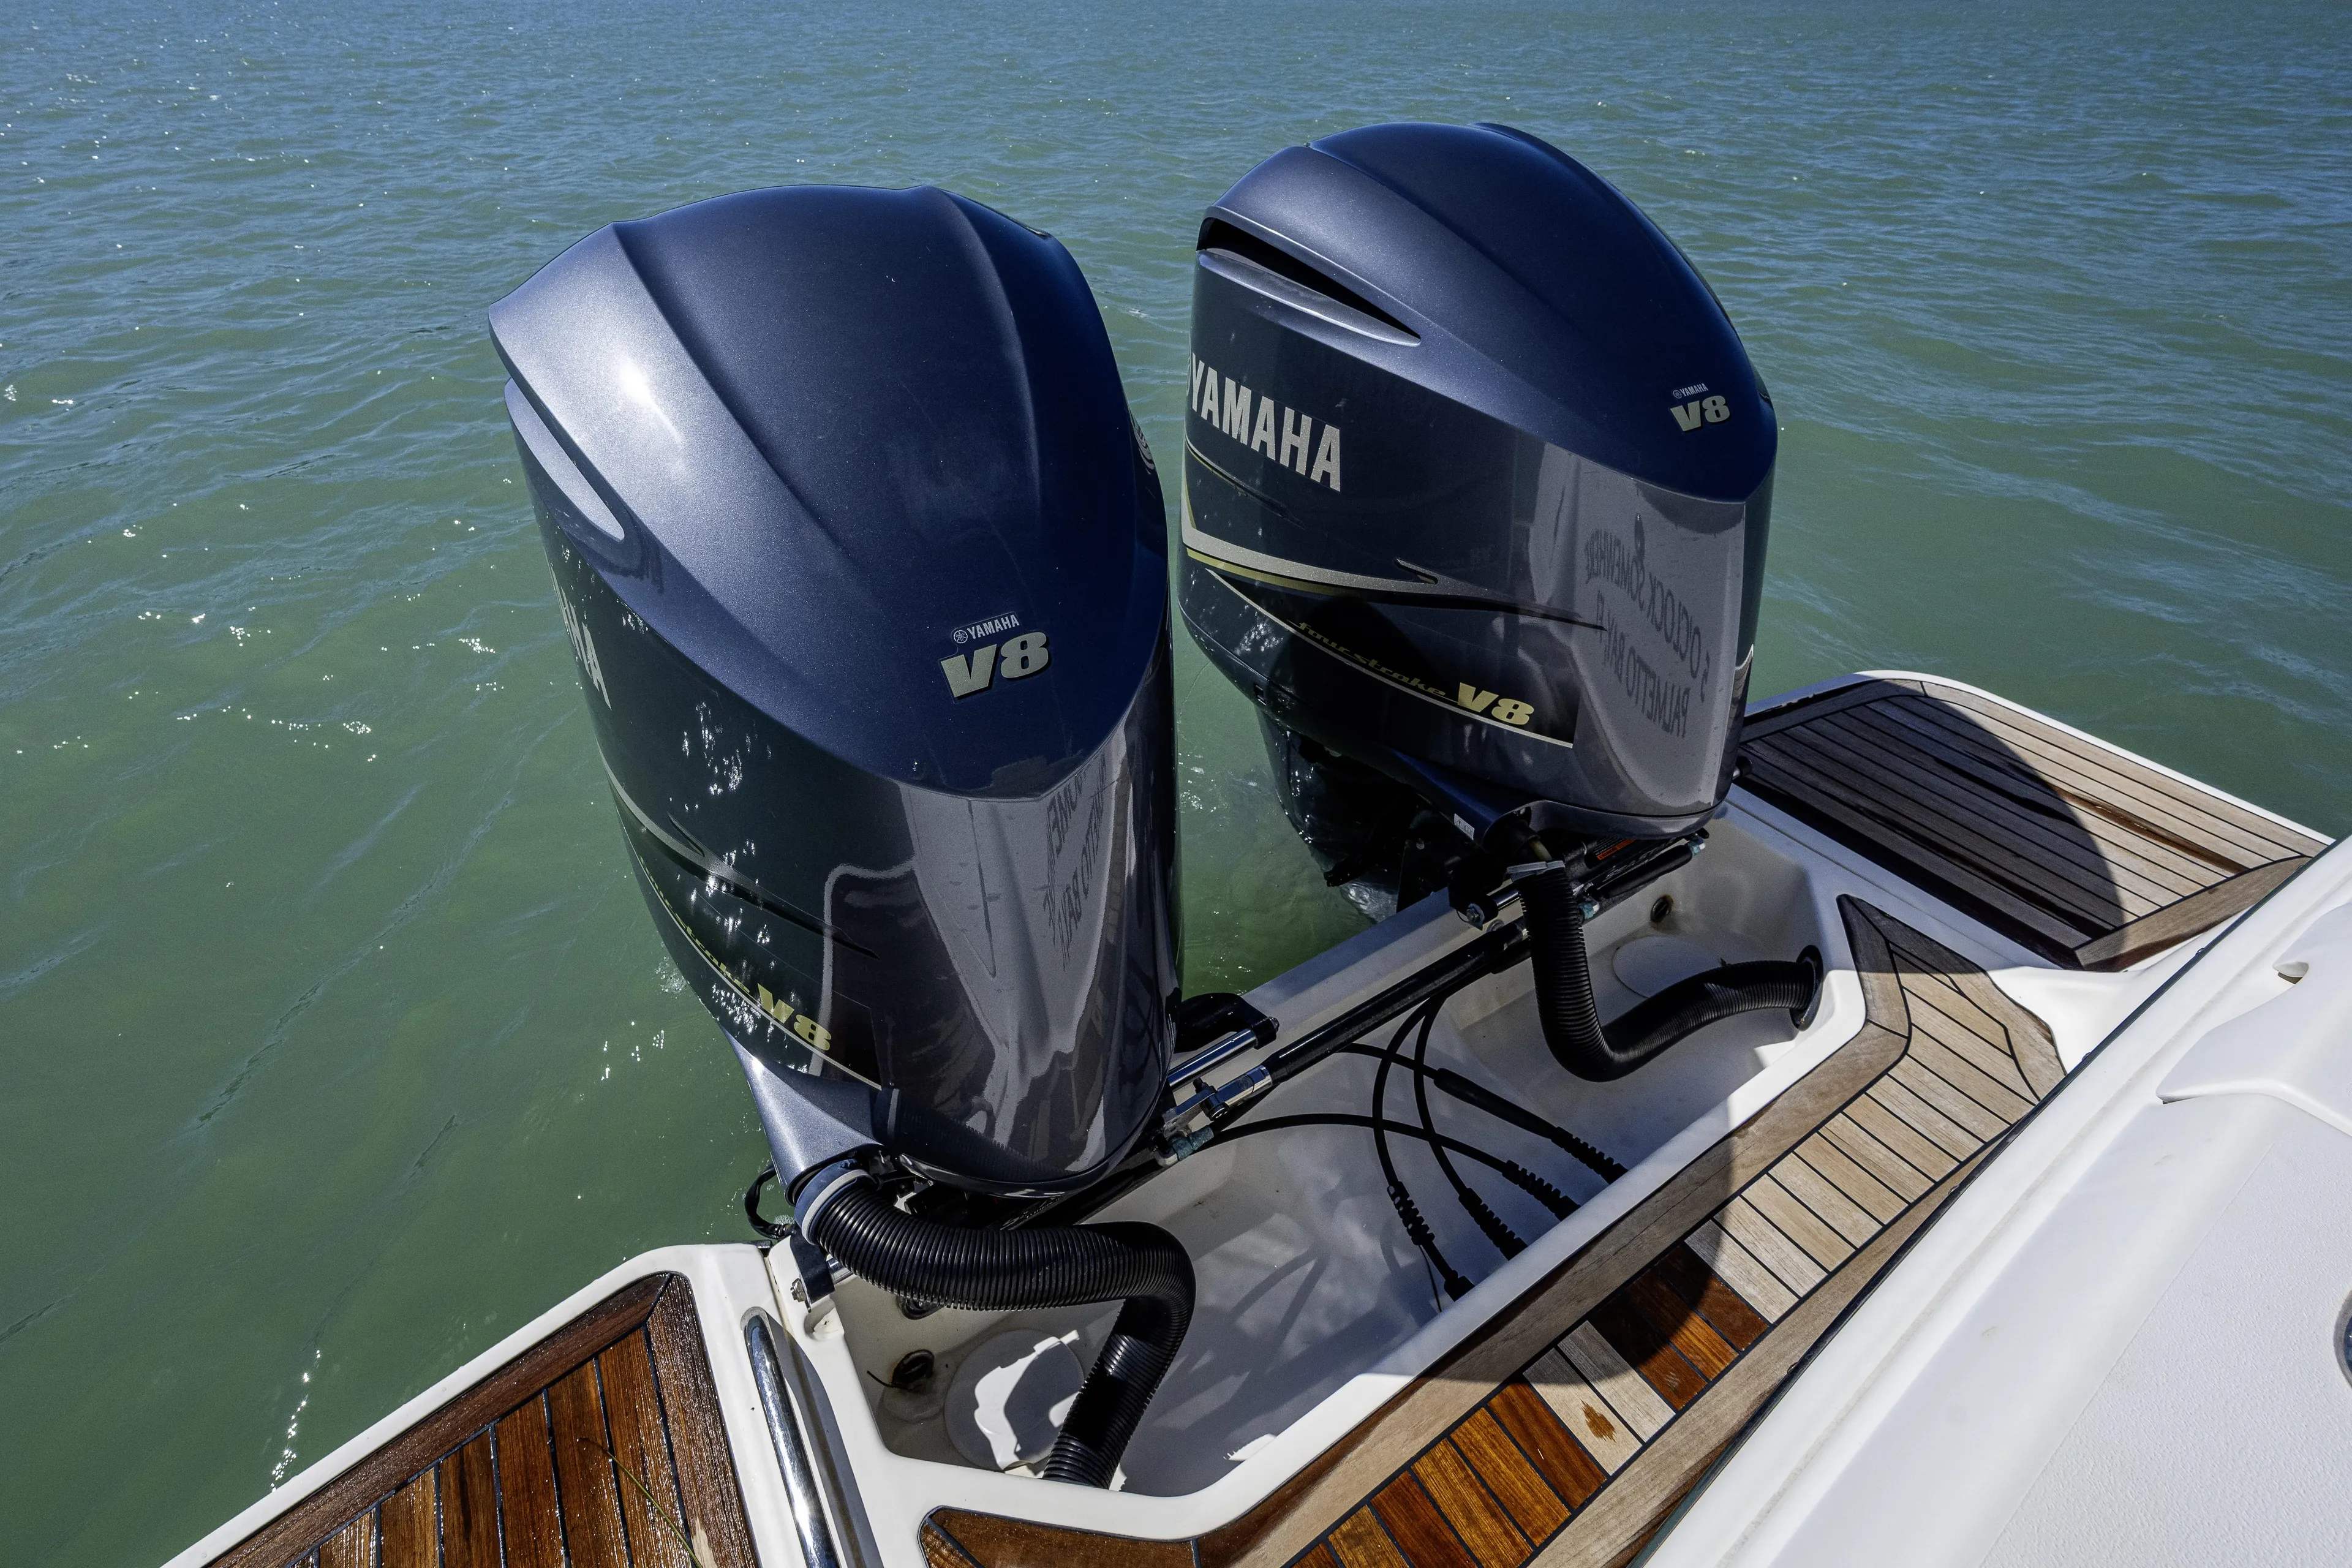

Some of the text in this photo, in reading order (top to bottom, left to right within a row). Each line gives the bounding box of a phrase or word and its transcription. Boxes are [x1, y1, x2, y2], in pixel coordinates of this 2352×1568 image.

[1670, 394, 1731, 432] V8
[1679, 383, 1709, 398] YAMAHA
[1191, 352, 1341, 492] YAMAHA
[967, 614, 1020, 640] YAMAHA
[940, 631, 1050, 698] V8
[1457, 681, 1534, 726] V8
[757, 982, 832, 1051] V8
